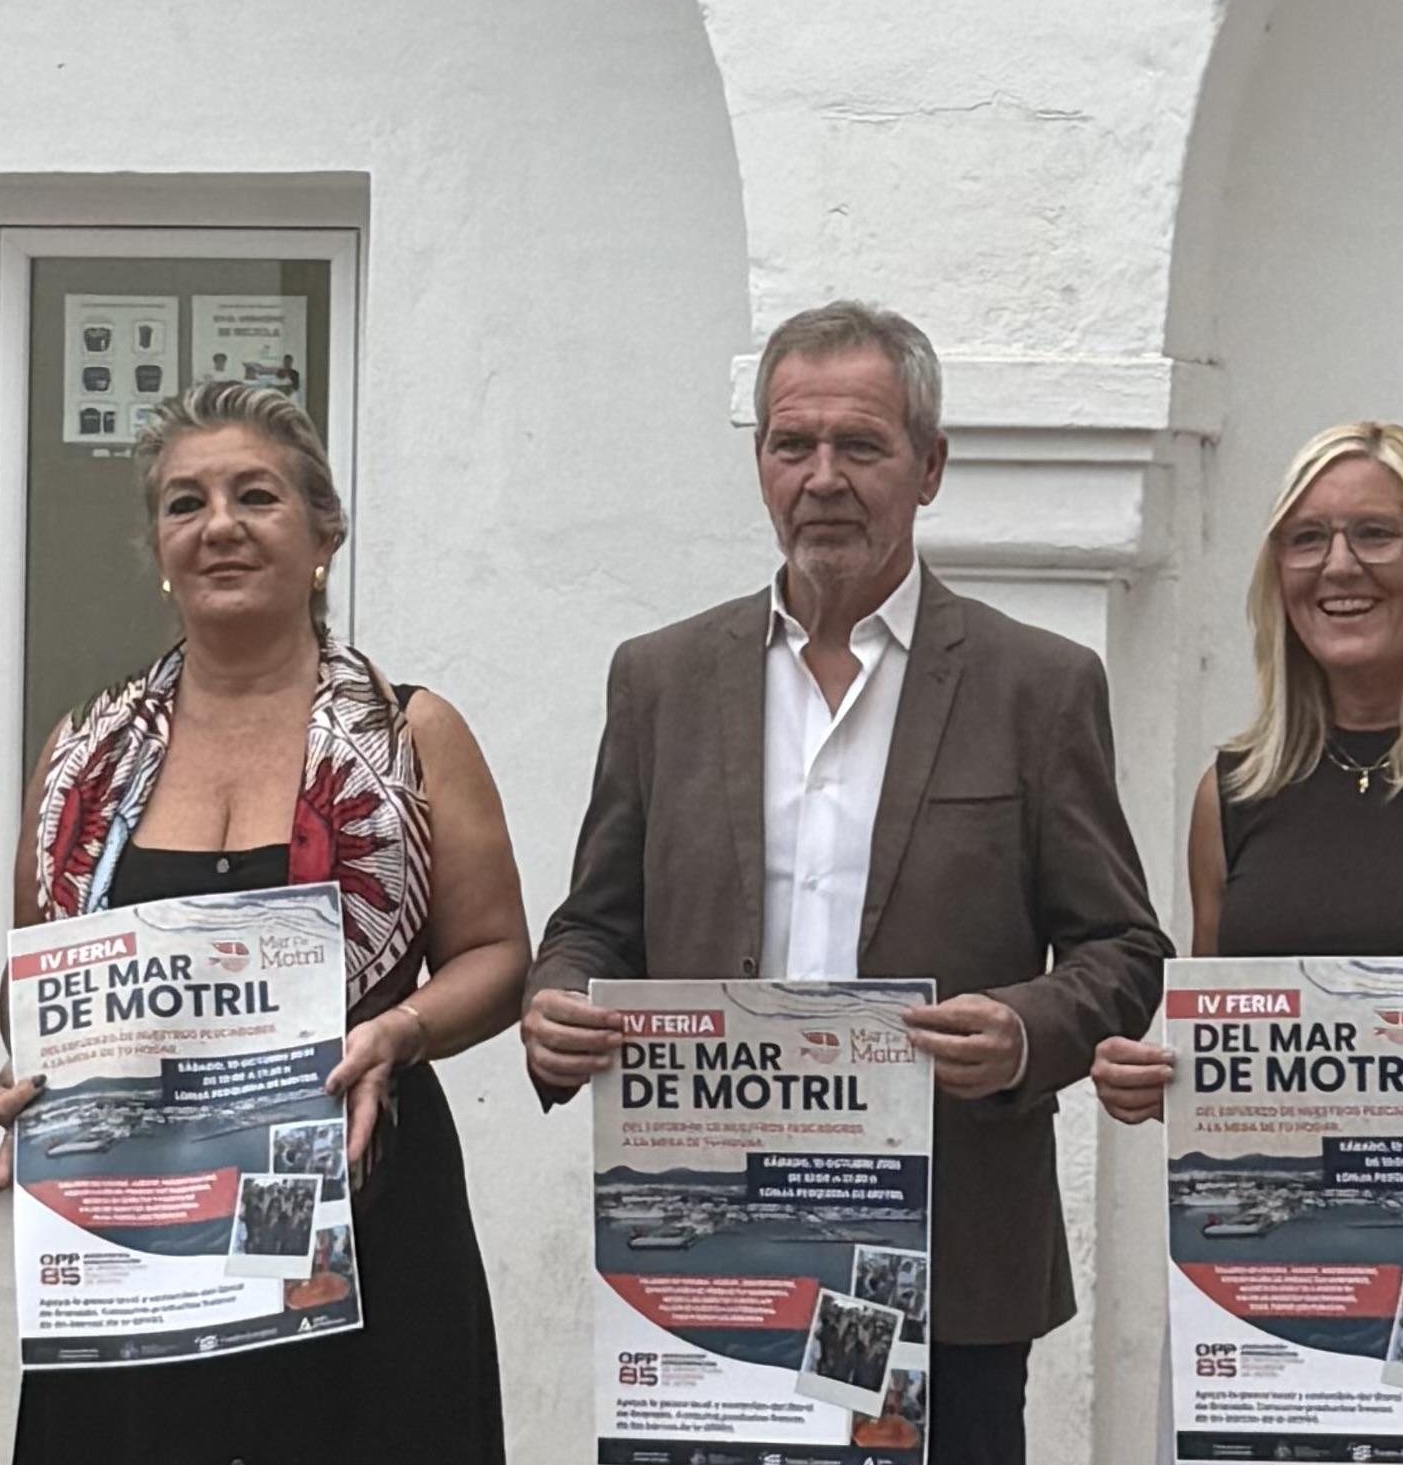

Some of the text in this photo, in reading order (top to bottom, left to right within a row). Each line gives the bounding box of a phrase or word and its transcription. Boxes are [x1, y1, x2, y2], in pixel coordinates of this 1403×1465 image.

[39, 937, 128, 971] IV FERIA
[260, 945, 325, 969] Motril
[38, 954, 192, 1003] DEL MAR
[39, 980, 280, 1036] DE MOTRIL
[1197, 994, 1291, 1014] IV FERIA
[624, 1015, 715, 1032] IV FERIA
[1193, 1023, 1356, 1052] DEL MAR
[621, 1042, 782, 1071] DEL MAR
[850, 1043, 916, 1063] Motril
[1195, 1056, 1252, 1092] DE
[622, 1074, 868, 1111] DE MOTRIL
[39, 1253, 80, 1266] OPP
[40, 1267, 81, 1285] 85
[618, 1352, 658, 1365] OPP
[1196, 1343, 1237, 1357] OPP
[619, 1367, 658, 1386] 85
[1196, 1358, 1237, 1378] 85
